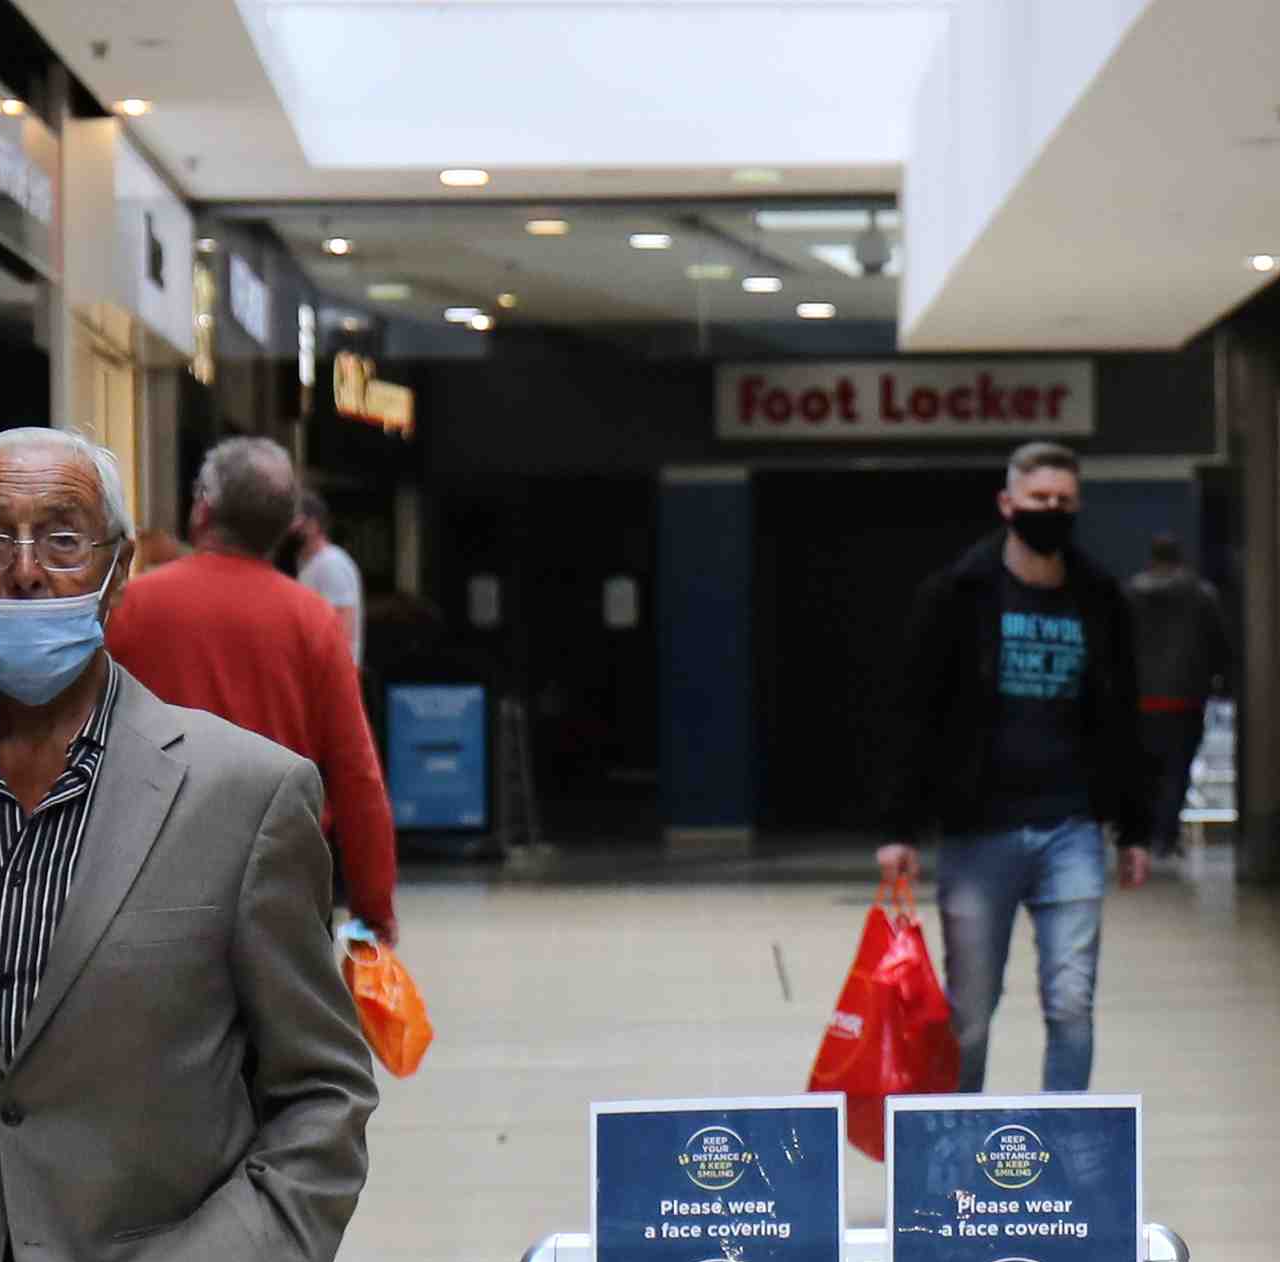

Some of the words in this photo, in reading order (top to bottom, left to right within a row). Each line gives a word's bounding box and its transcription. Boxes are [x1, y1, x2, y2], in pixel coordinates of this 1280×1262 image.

[737, 373, 860, 425] Foot
[878, 372, 1070, 424] Locker
[703, 1136, 728, 1144] KEEP
[1001, 1135, 1026, 1143] KEEP
[1000, 1144, 1026, 1152] YOUR
[692, 1153, 740, 1162] DISTANCE
[990, 1152, 1037, 1161] DISTANCE
[708, 1162, 733, 1170] KEEP
[1006, 1160, 1030, 1168] KEEP
[994, 1168, 1032, 1177] SMILING
[660, 1200, 721, 1216] Please
[728, 1201, 775, 1214] wear
[958, 1199, 1020, 1214] Please
[1025, 1200, 1073, 1213] wear
[644, 1226, 656, 1239] a
[661, 1223, 702, 1238] face
[707, 1220, 791, 1238] covering
[942, 1224, 953, 1236] a
[958, 1221, 999, 1236] face
[1004, 1220, 1088, 1238] covering
